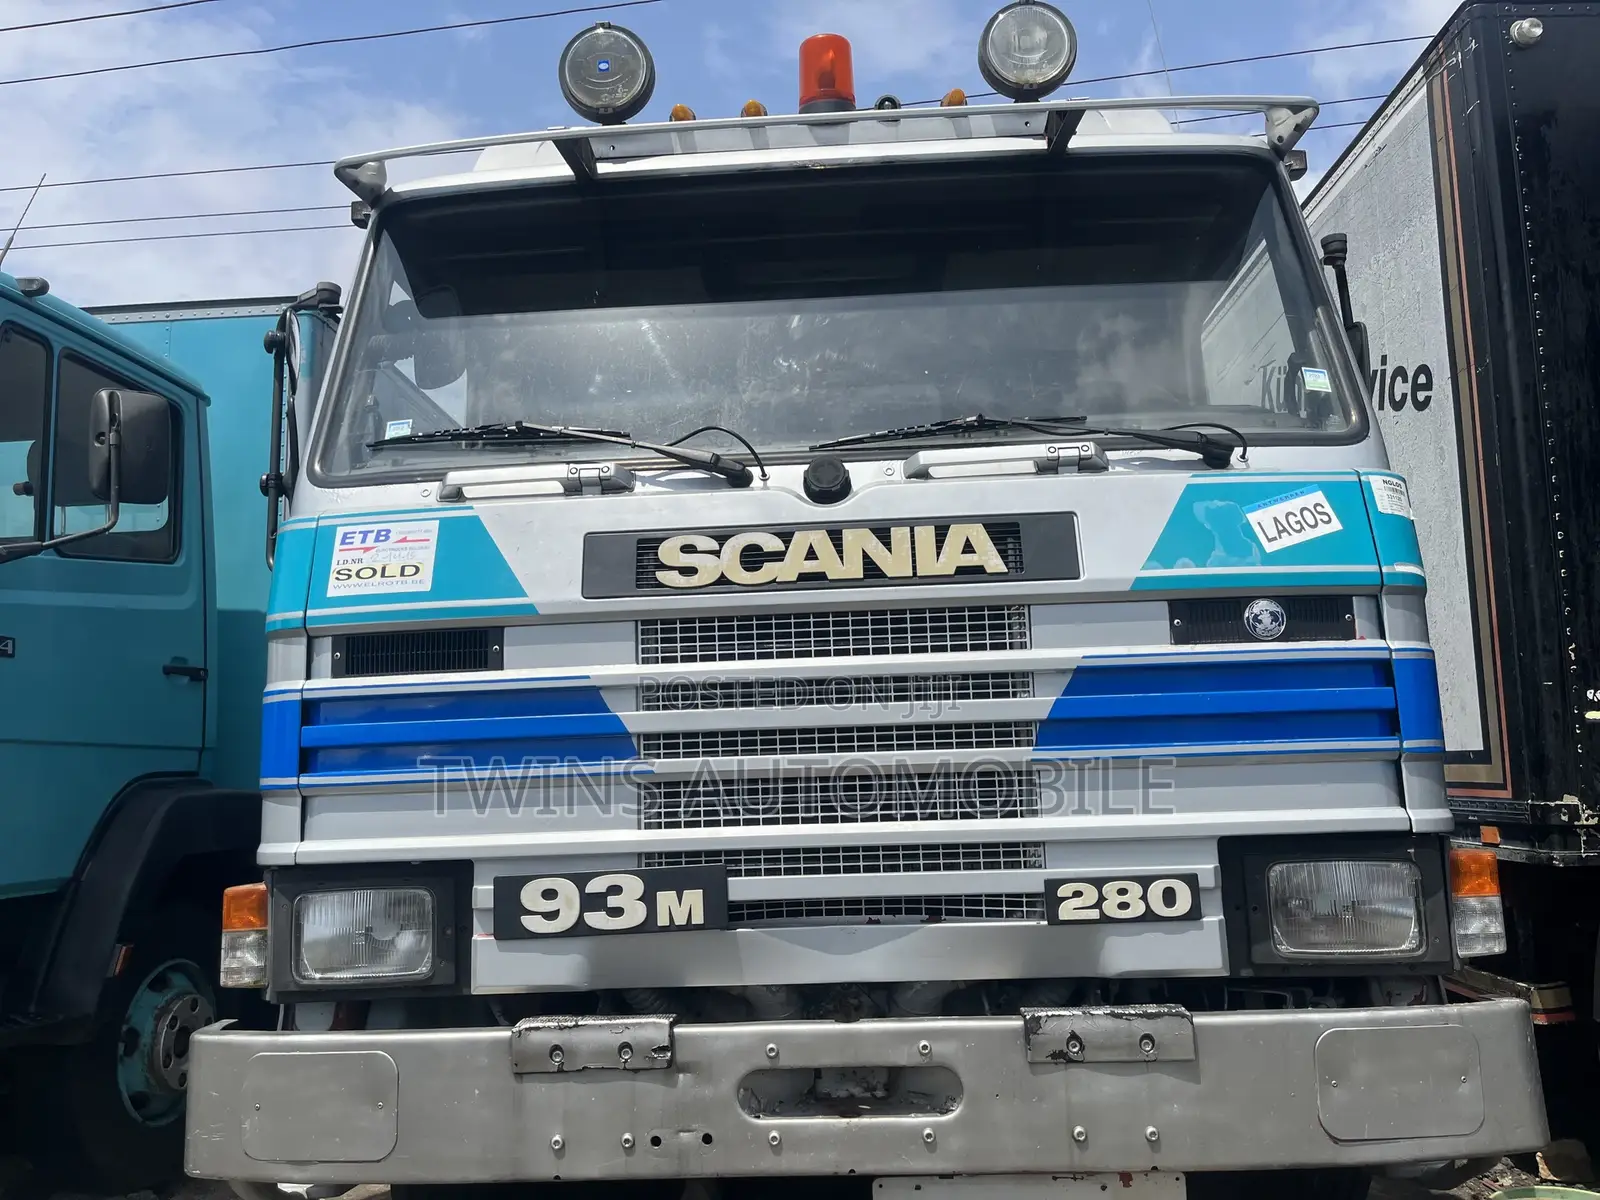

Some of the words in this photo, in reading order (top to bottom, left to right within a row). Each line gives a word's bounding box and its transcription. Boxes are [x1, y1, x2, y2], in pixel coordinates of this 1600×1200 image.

[339, 528, 392, 546] ETB
[1257, 502, 1333, 544] LAGOS
[334, 563, 421, 582] SOLD
[654, 522, 1009, 588] SCANIA
[1056, 878, 1192, 921] 280
